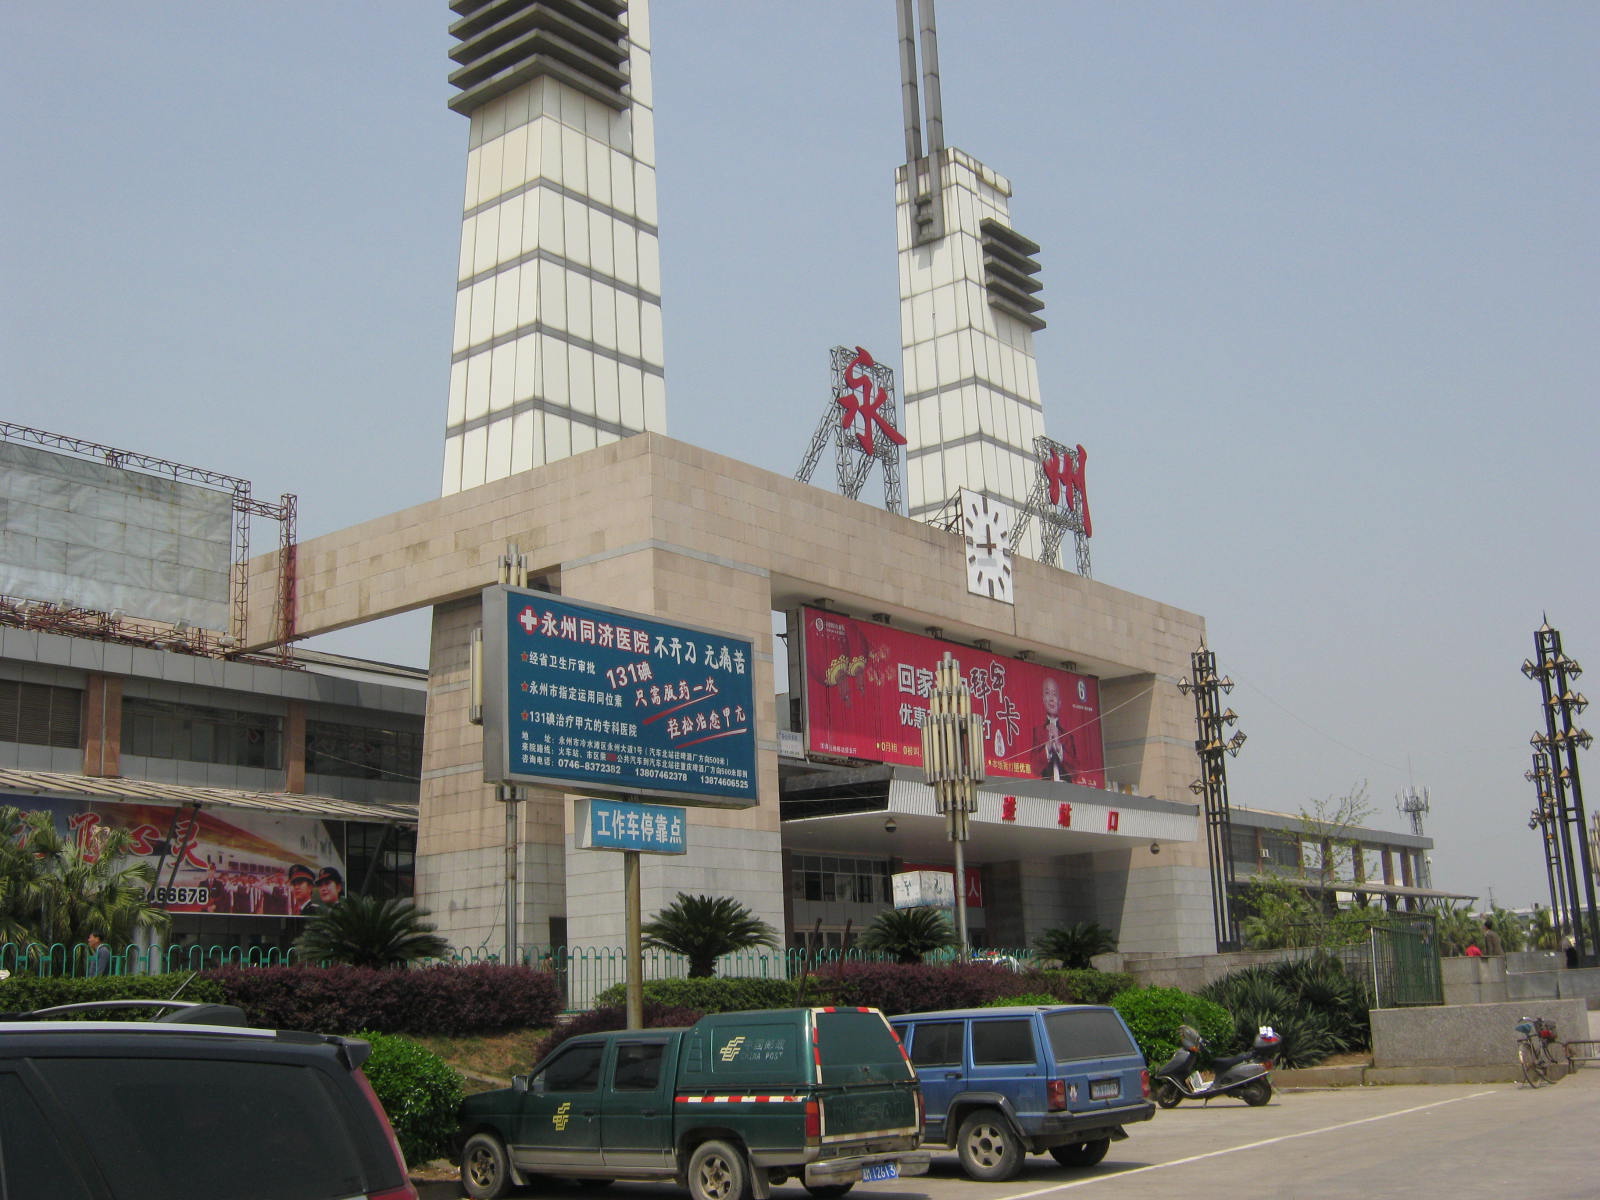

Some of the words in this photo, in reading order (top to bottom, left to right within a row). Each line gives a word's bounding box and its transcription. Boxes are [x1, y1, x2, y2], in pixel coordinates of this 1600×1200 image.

[837, 346, 907, 456] 永
[1043, 444, 1092, 538] 州
[540, 611, 650, 655] 永州同济医院
[653, 636, 698, 665] 不开刀
[704, 644, 746, 674] 无痛苦
[529, 651, 596, 675] 经省卫生厅审批
[606, 660, 653, 689] 131碘
[529, 681, 623, 708] 永州市指定运用同位素
[635, 675, 719, 708] 只需服药一次
[529, 711, 638, 738] 131碘治疗甲亢的专科医院
[667, 705, 746, 740] 轻松治愈甲亢
[557, 758, 622, 774] 0746-8372382
[634, 768, 688, 782] 13807462378
[597, 809, 682, 844] 工作车停靠点
